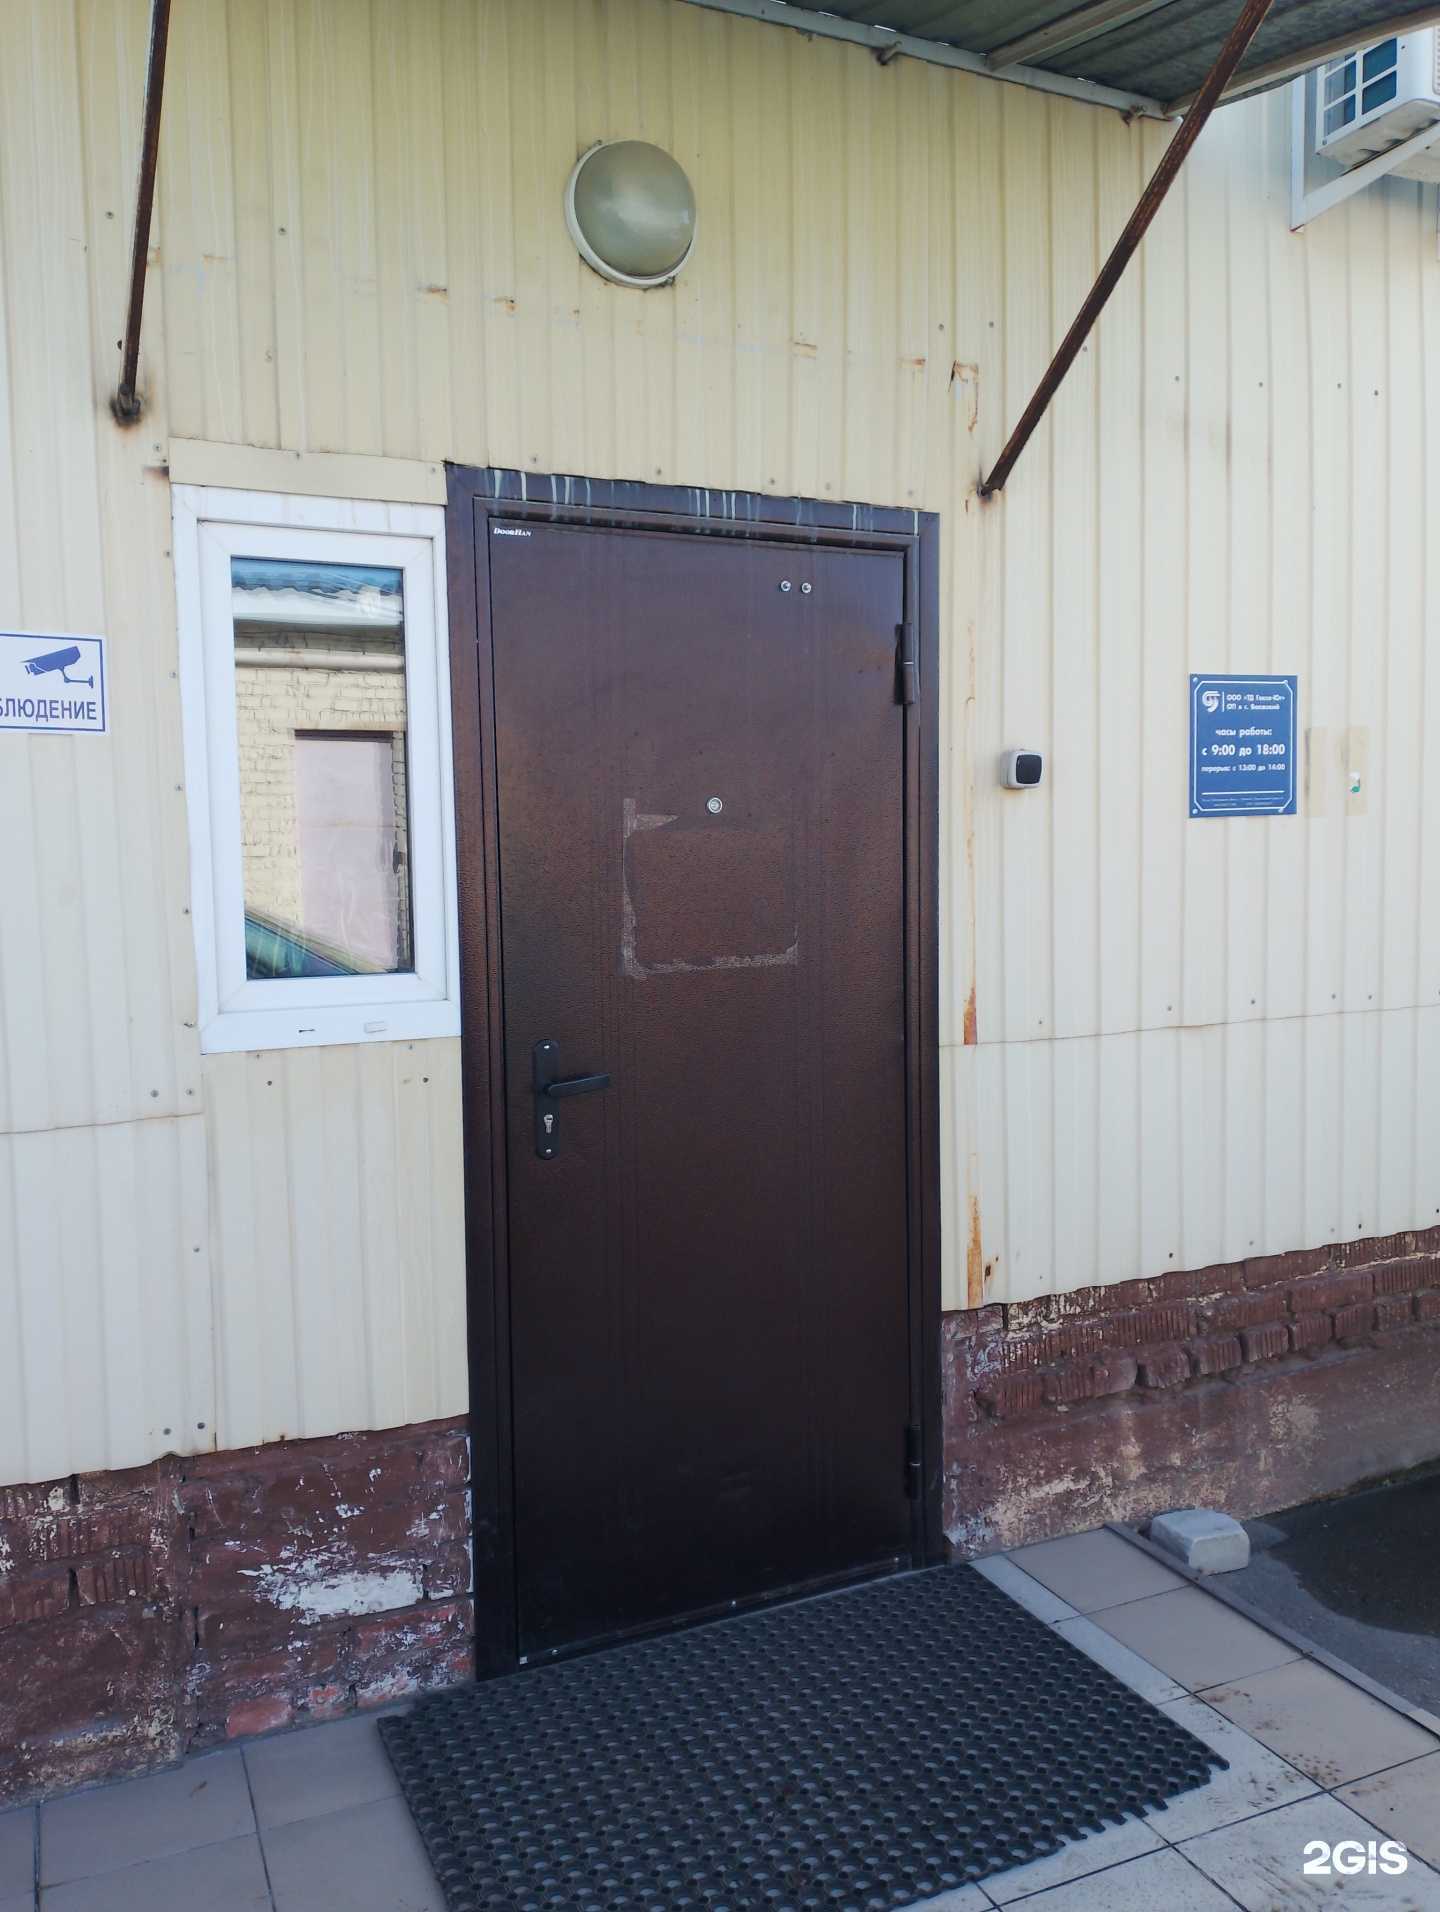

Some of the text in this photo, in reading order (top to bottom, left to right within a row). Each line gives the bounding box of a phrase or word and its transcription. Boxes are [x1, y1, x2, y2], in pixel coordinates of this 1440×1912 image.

[1239, 726, 1273, 738] работы:
[1201, 743, 1286, 757] с 9:00 до 18:00
